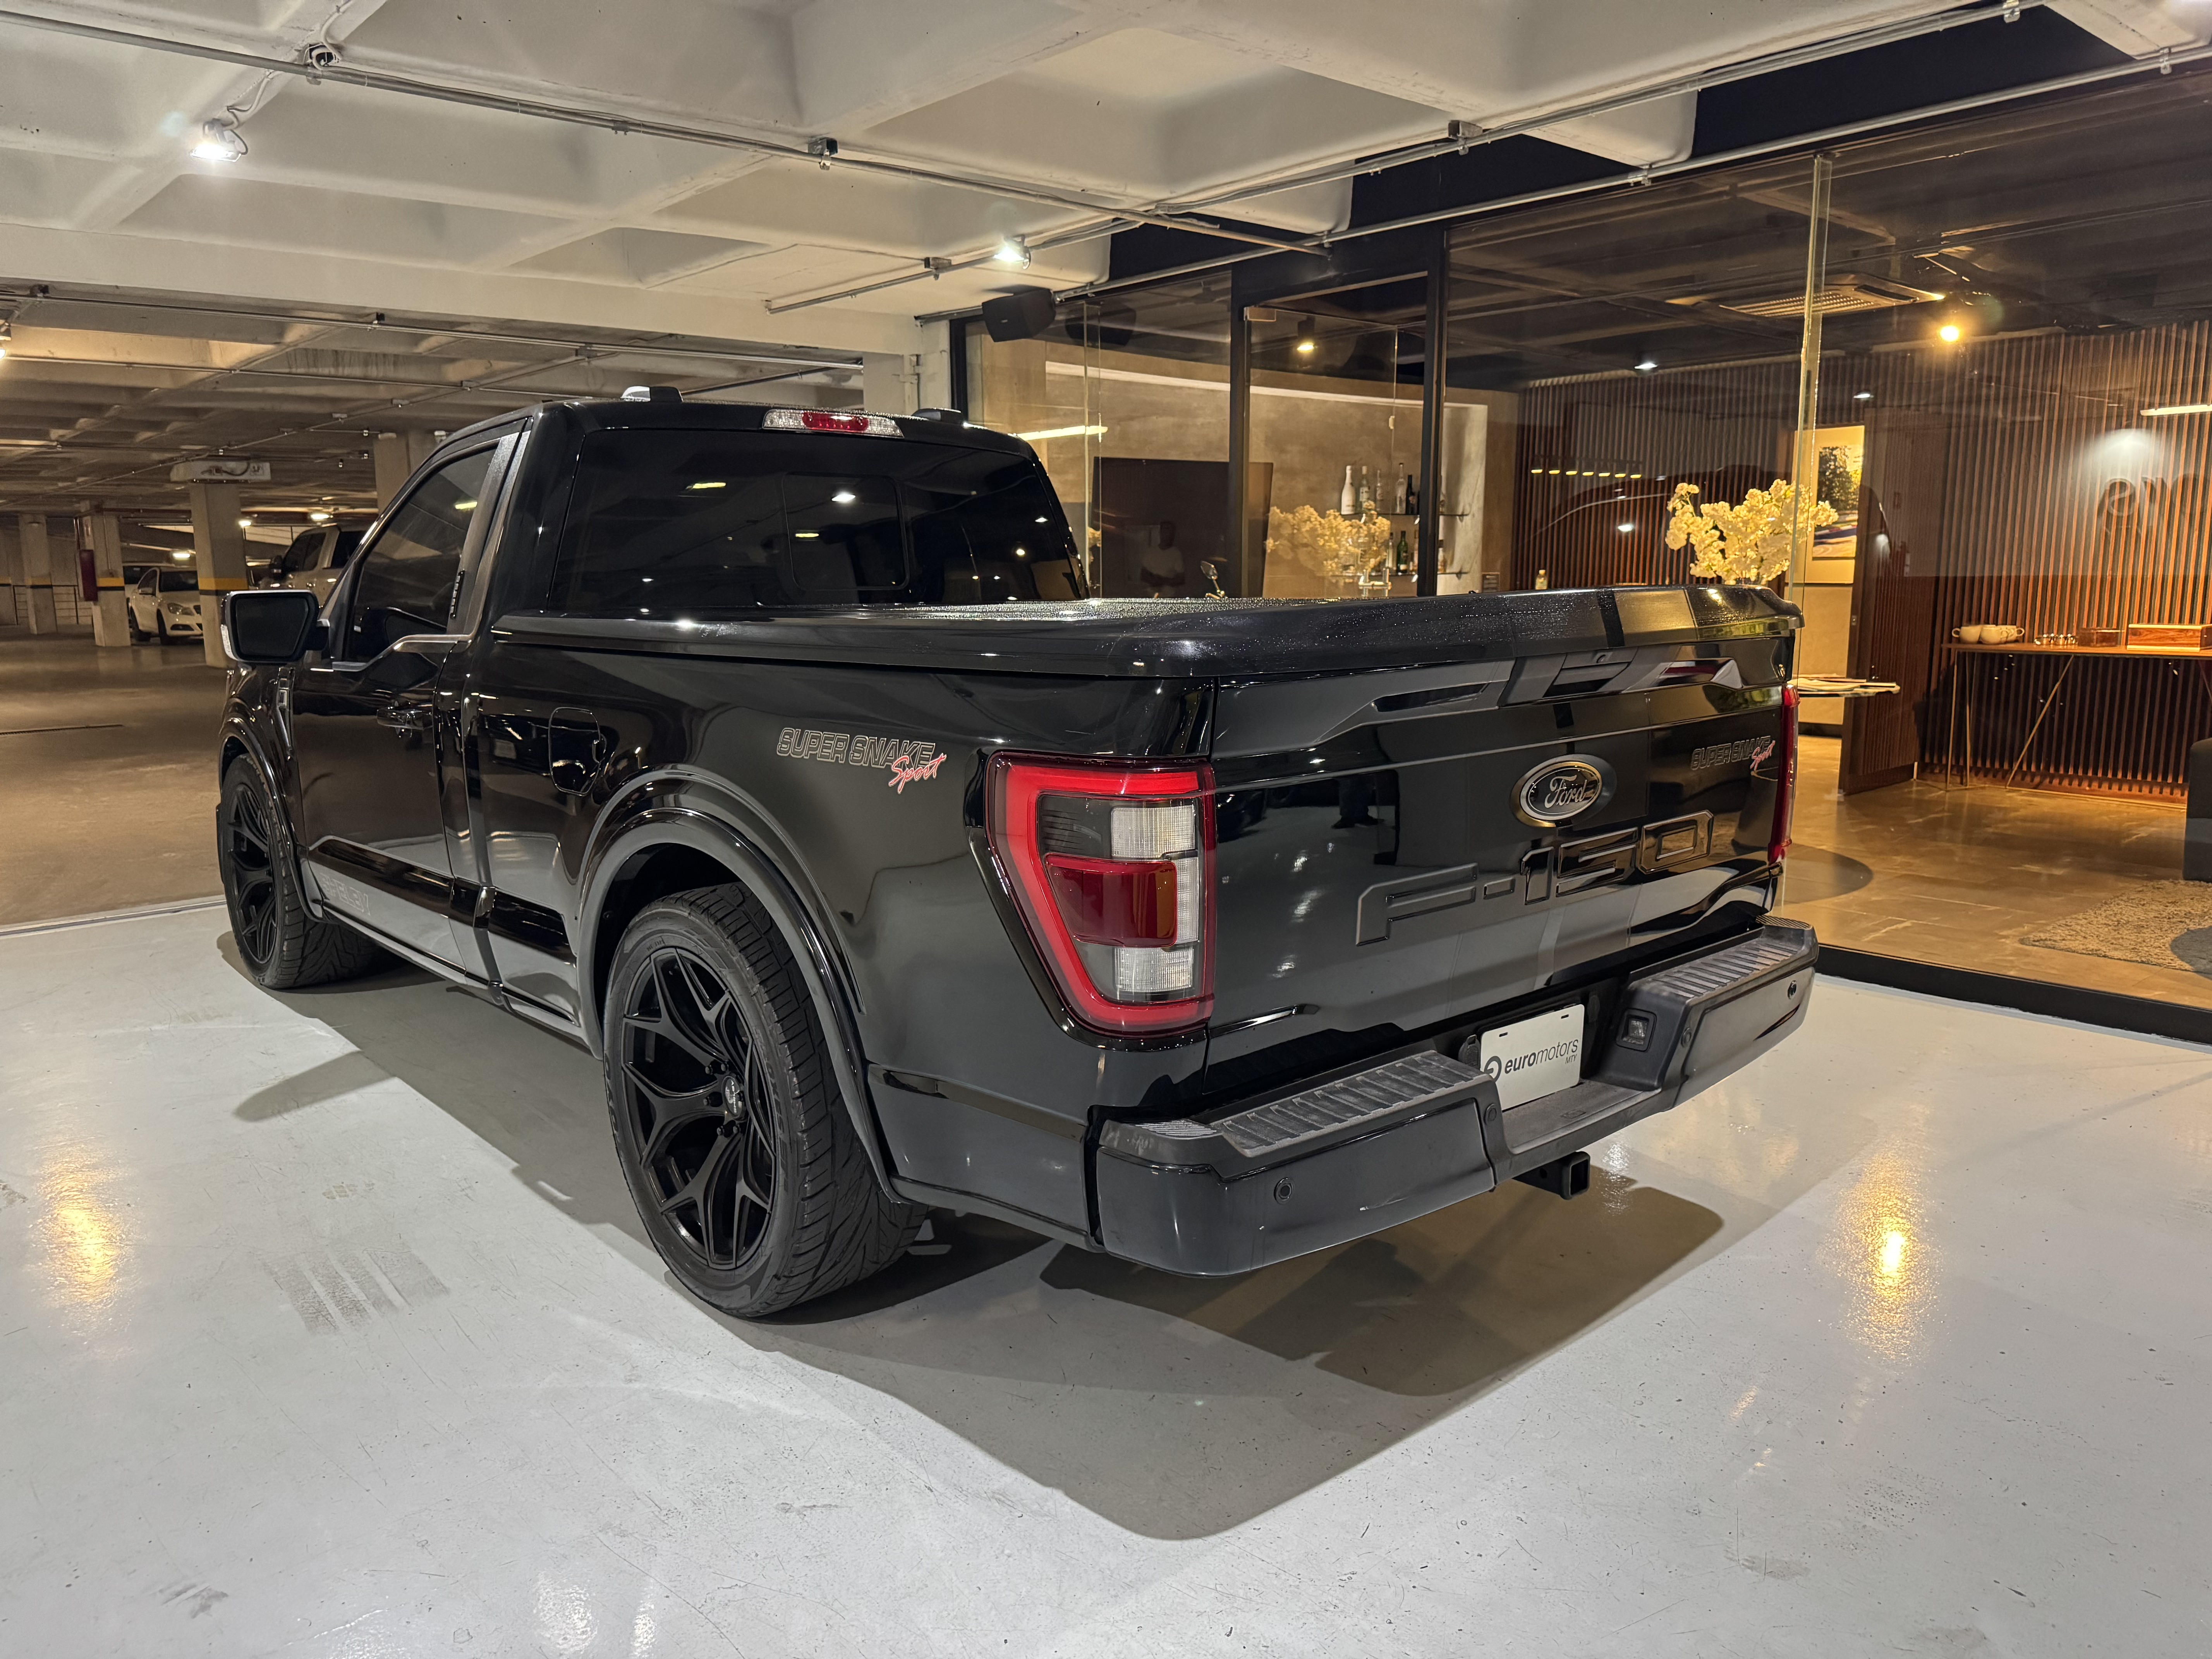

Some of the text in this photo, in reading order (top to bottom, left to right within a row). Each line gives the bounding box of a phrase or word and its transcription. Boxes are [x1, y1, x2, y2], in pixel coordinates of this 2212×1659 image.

[777, 728, 936, 769] SUPER SNAKE
[1691, 735, 1771, 770] SUPER SNAKE
[1750, 740, 1776, 771] Sport
[888, 752, 947, 794] Sport
[1544, 775, 1587, 808] Ford
[1356, 809, 1714, 946] F-150
[1504, 1039, 1578, 1074] euromotors
[1565, 1054, 1577, 1065] MTY
